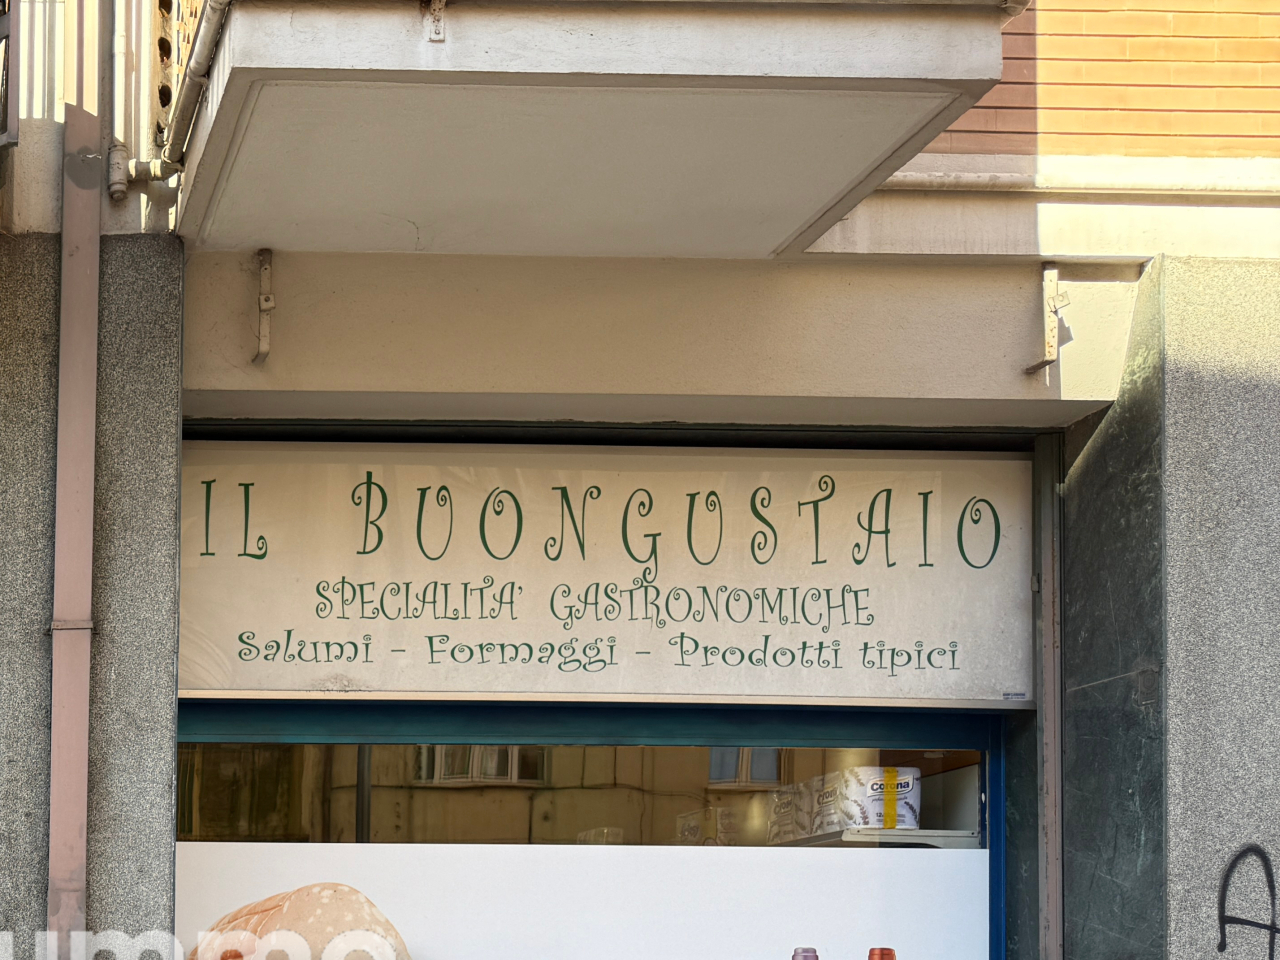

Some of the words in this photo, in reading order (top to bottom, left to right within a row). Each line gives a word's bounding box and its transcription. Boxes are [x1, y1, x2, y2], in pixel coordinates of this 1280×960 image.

[199, 478, 268, 560] IL
[350, 471, 1001, 584] BUONGUSTAIO
[549, 577, 875, 633] GASTRONOMICHE
[237, 629, 374, 664] Salumi
[424, 634, 619, 673] Formaggi
[667, 631, 843, 669] Prodotti
[858, 640, 961, 677] tipici
